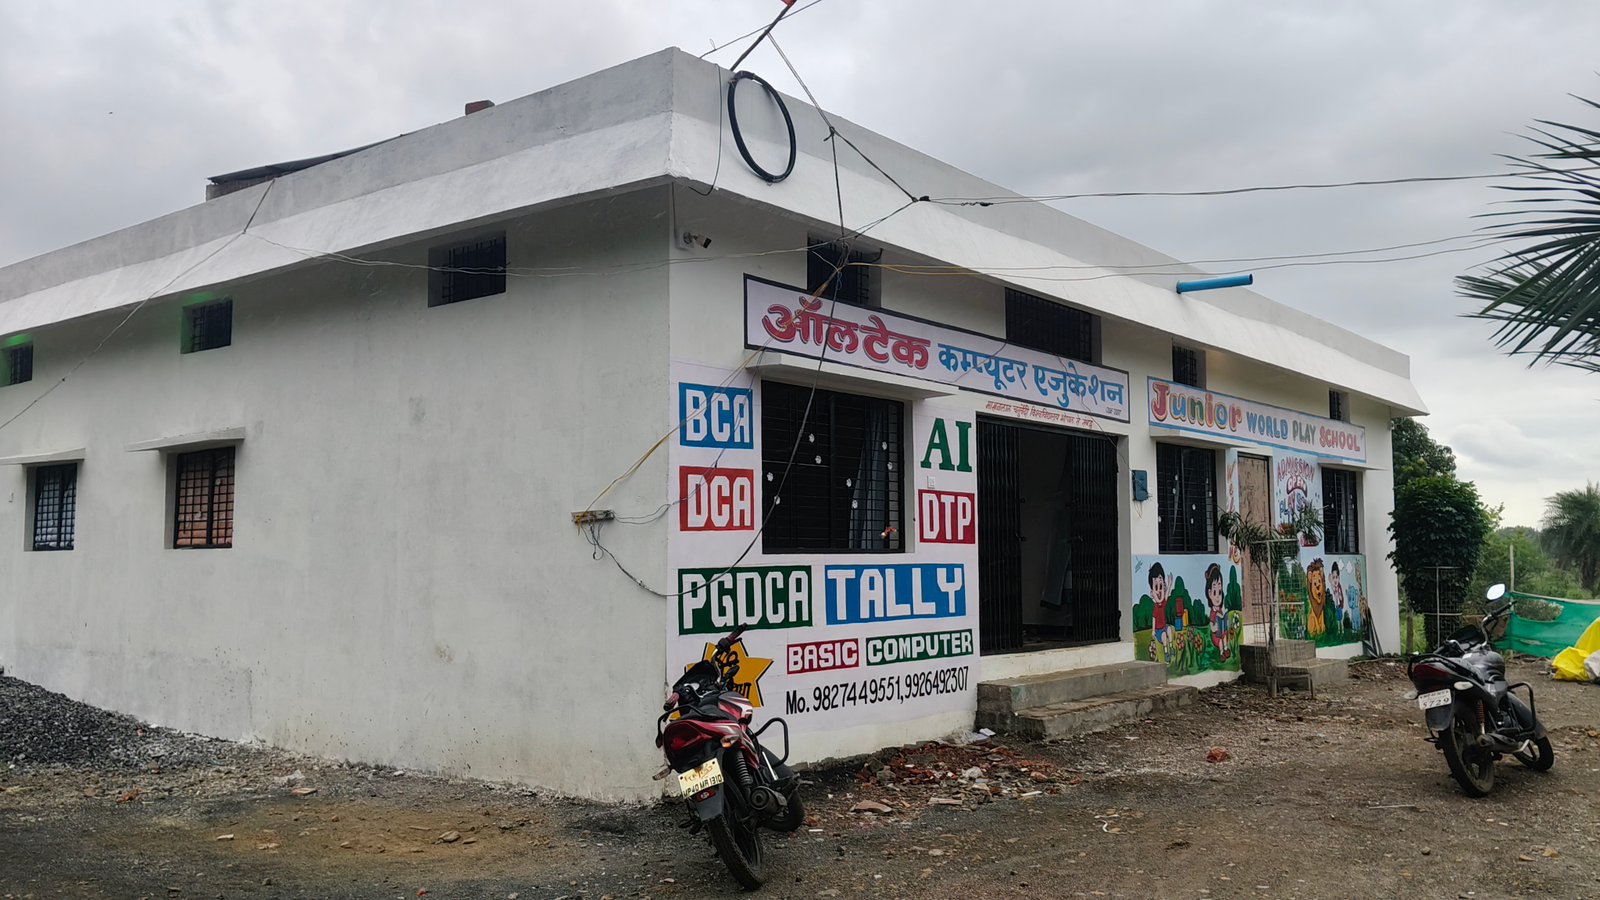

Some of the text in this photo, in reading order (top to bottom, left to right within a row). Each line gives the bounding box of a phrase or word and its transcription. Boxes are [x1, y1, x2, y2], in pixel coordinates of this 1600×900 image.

[762, 296, 931, 370] ऑलटेक
[1032, 361, 1124, 408] एजुकेशन
[685, 388, 750, 443] BCA
[1151, 381, 1361, 452] Junior WORLD PLAY SCHOOL
[920, 417, 972, 472] AI
[1277, 456, 1315, 488] ADMISSION
[687, 474, 751, 528] DCA
[922, 493, 972, 540] DTP
[682, 567, 963, 629] PGDCA TALLY
[788, 631, 972, 672] BASIC COMPUTER
[785, 690, 810, 715] Mo.
